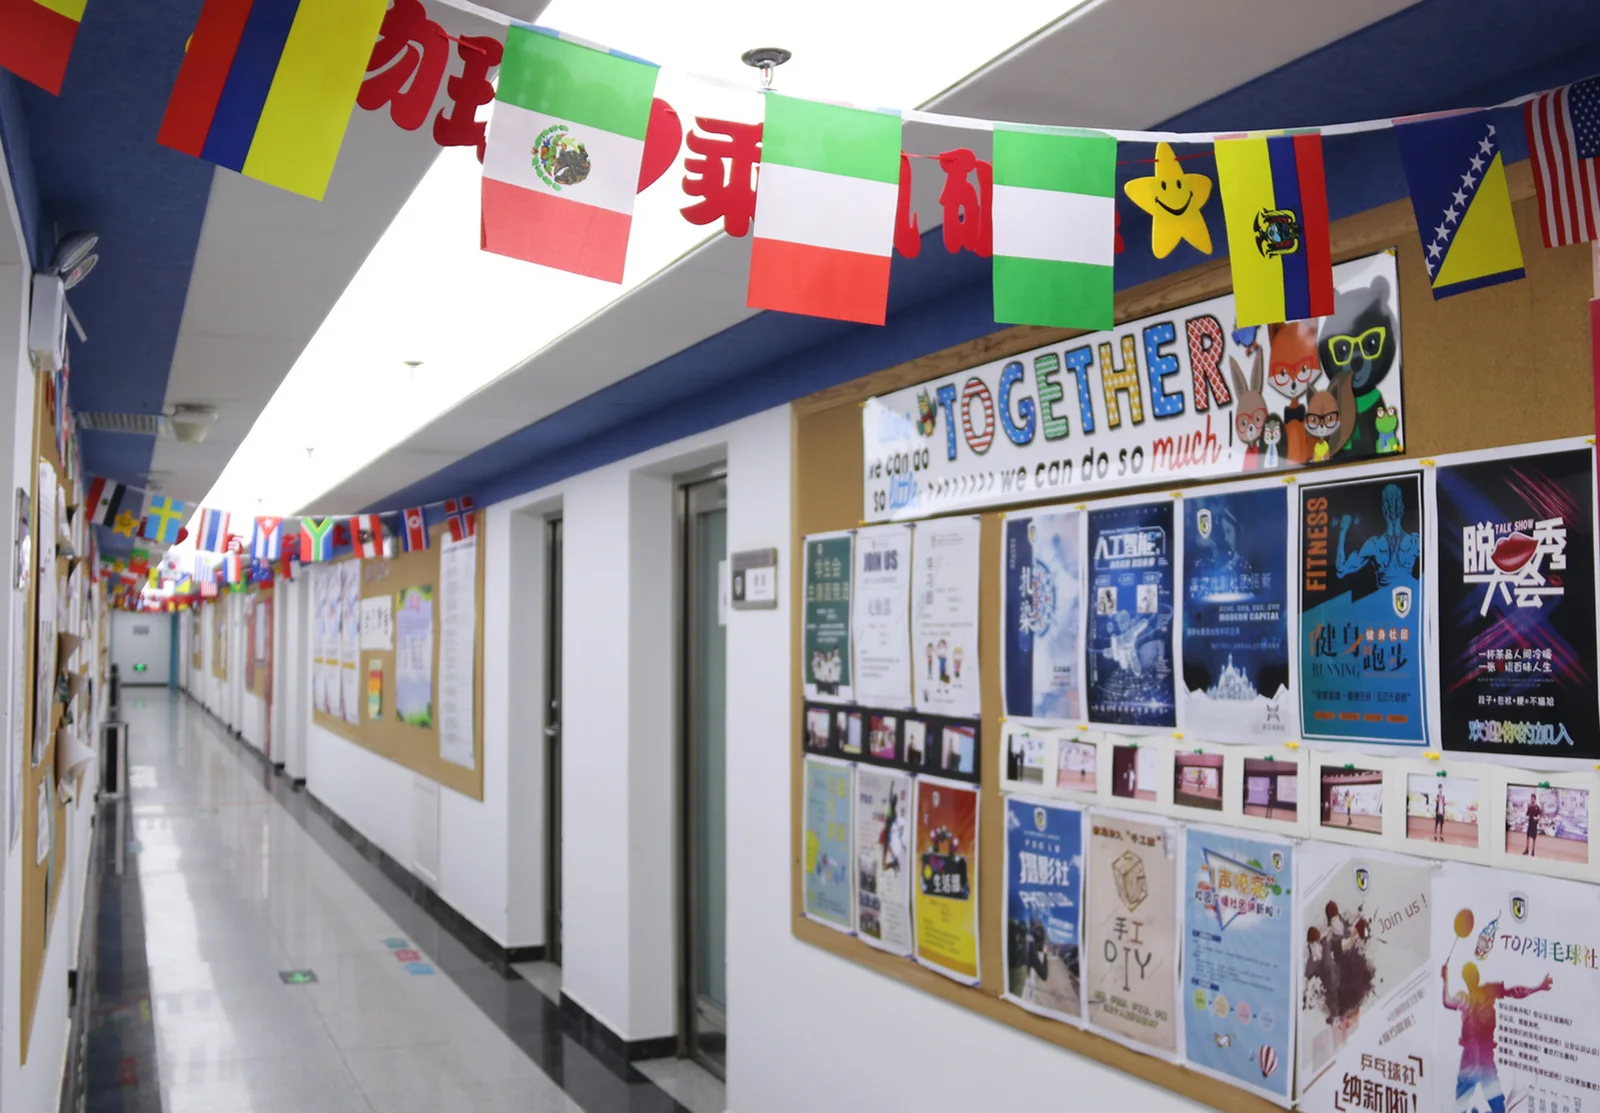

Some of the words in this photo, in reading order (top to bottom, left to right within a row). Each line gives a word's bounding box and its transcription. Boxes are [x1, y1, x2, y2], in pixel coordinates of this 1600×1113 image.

[935, 314, 1231, 461] TOGETHER
[886, 452, 908, 476] can
[913, 444, 929, 471] do
[1001, 465, 1027, 494] we
[1035, 457, 1073, 488] can
[1081, 446, 1108, 482] do
[1118, 445, 1144, 477] so
[874, 489, 886, 512] so
[1495, 522, 1512, 535] TALK
[1514, 518, 1534, 532] SHOW
[1305, 496, 1328, 592] FITNESS
[864, 551, 882, 573] JOIN
[884, 550, 898, 571] US
[1249, 611, 1279, 621] CAPITAL
[1468, 719, 1574, 746] 欢迎你的加入
[1113, 917, 1144, 945] 手工
[1379, 910, 1404, 934] Join
[1405, 900, 1421, 919] us
[1361, 1053, 1416, 1086] 乒乓球社
